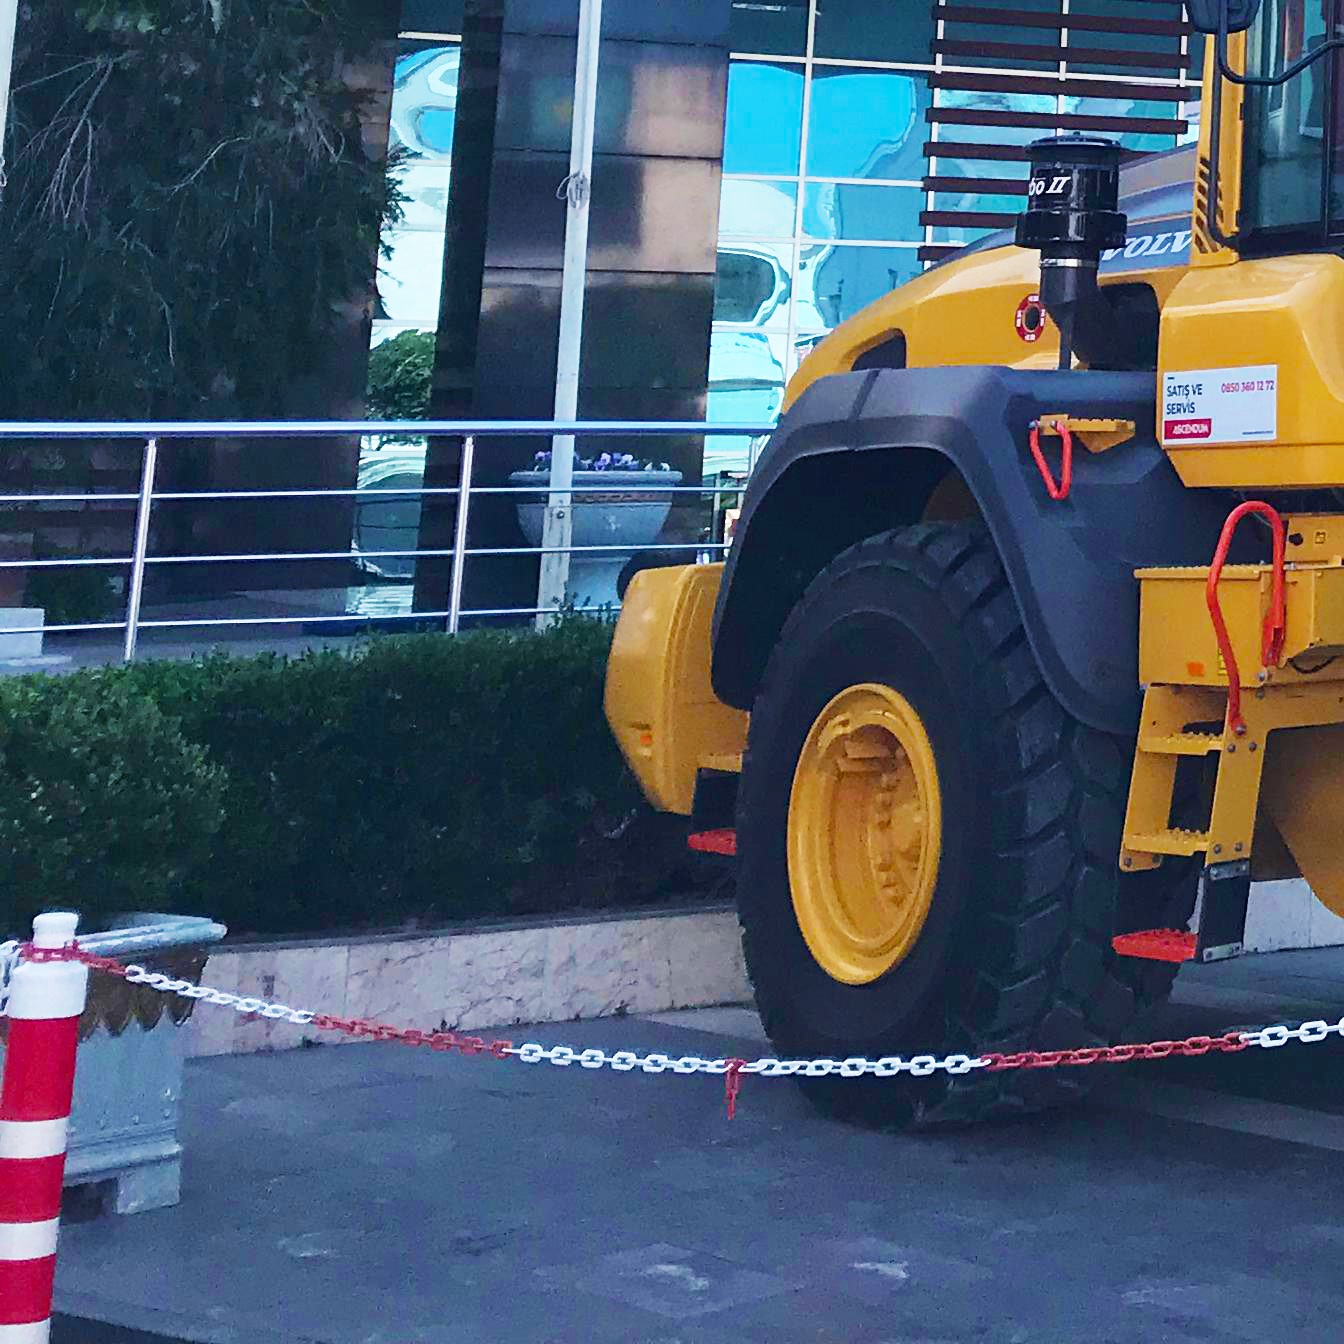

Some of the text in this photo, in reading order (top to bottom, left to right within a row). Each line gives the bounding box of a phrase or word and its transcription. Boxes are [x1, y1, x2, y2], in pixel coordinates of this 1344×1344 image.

[1167, 384, 1203, 399] SATIŞ VE
[1166, 399, 1196, 415] SERVİS
